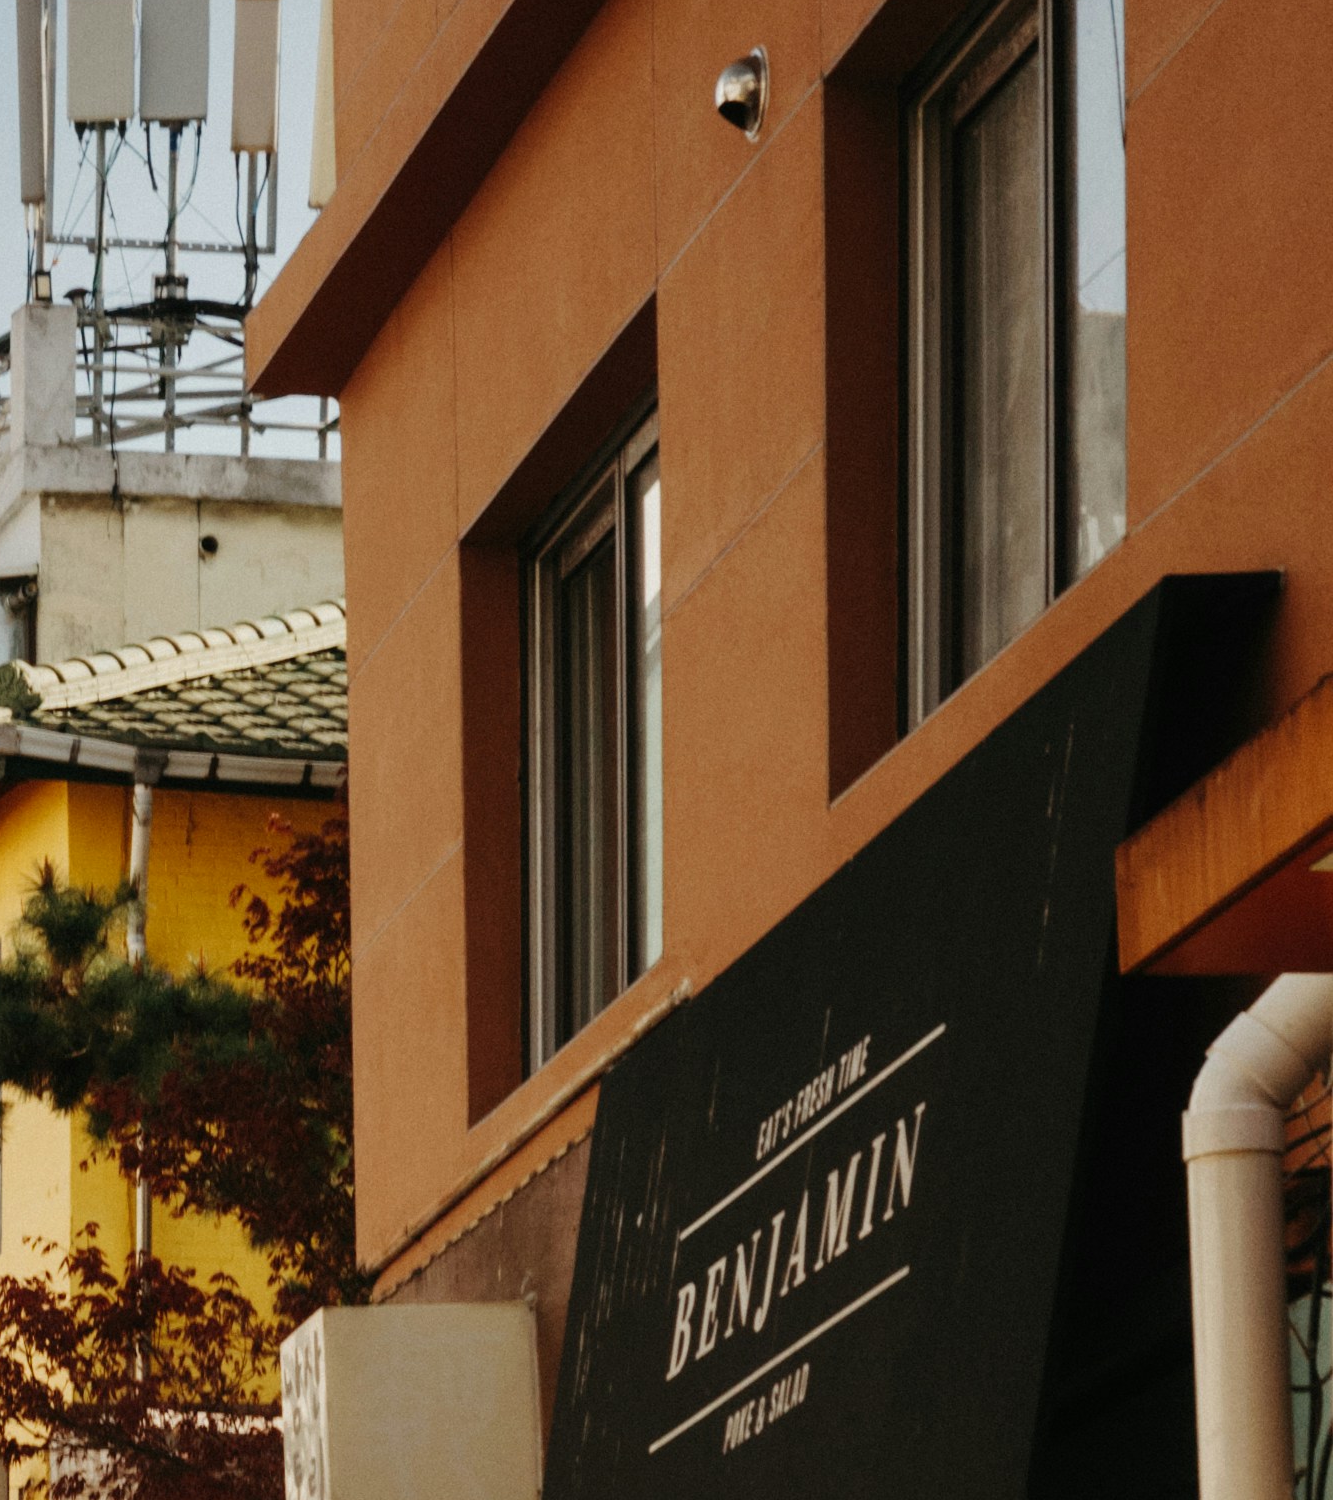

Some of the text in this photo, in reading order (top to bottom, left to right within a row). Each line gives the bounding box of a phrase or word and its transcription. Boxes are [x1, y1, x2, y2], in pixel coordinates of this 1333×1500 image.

[756, 1035, 871, 1161] EAT'S FRESH TIME
[666, 1102, 927, 1381] BENJAMIN
[723, 1411, 755, 1455] POKE
[768, 1363, 810, 1423] SALAD
